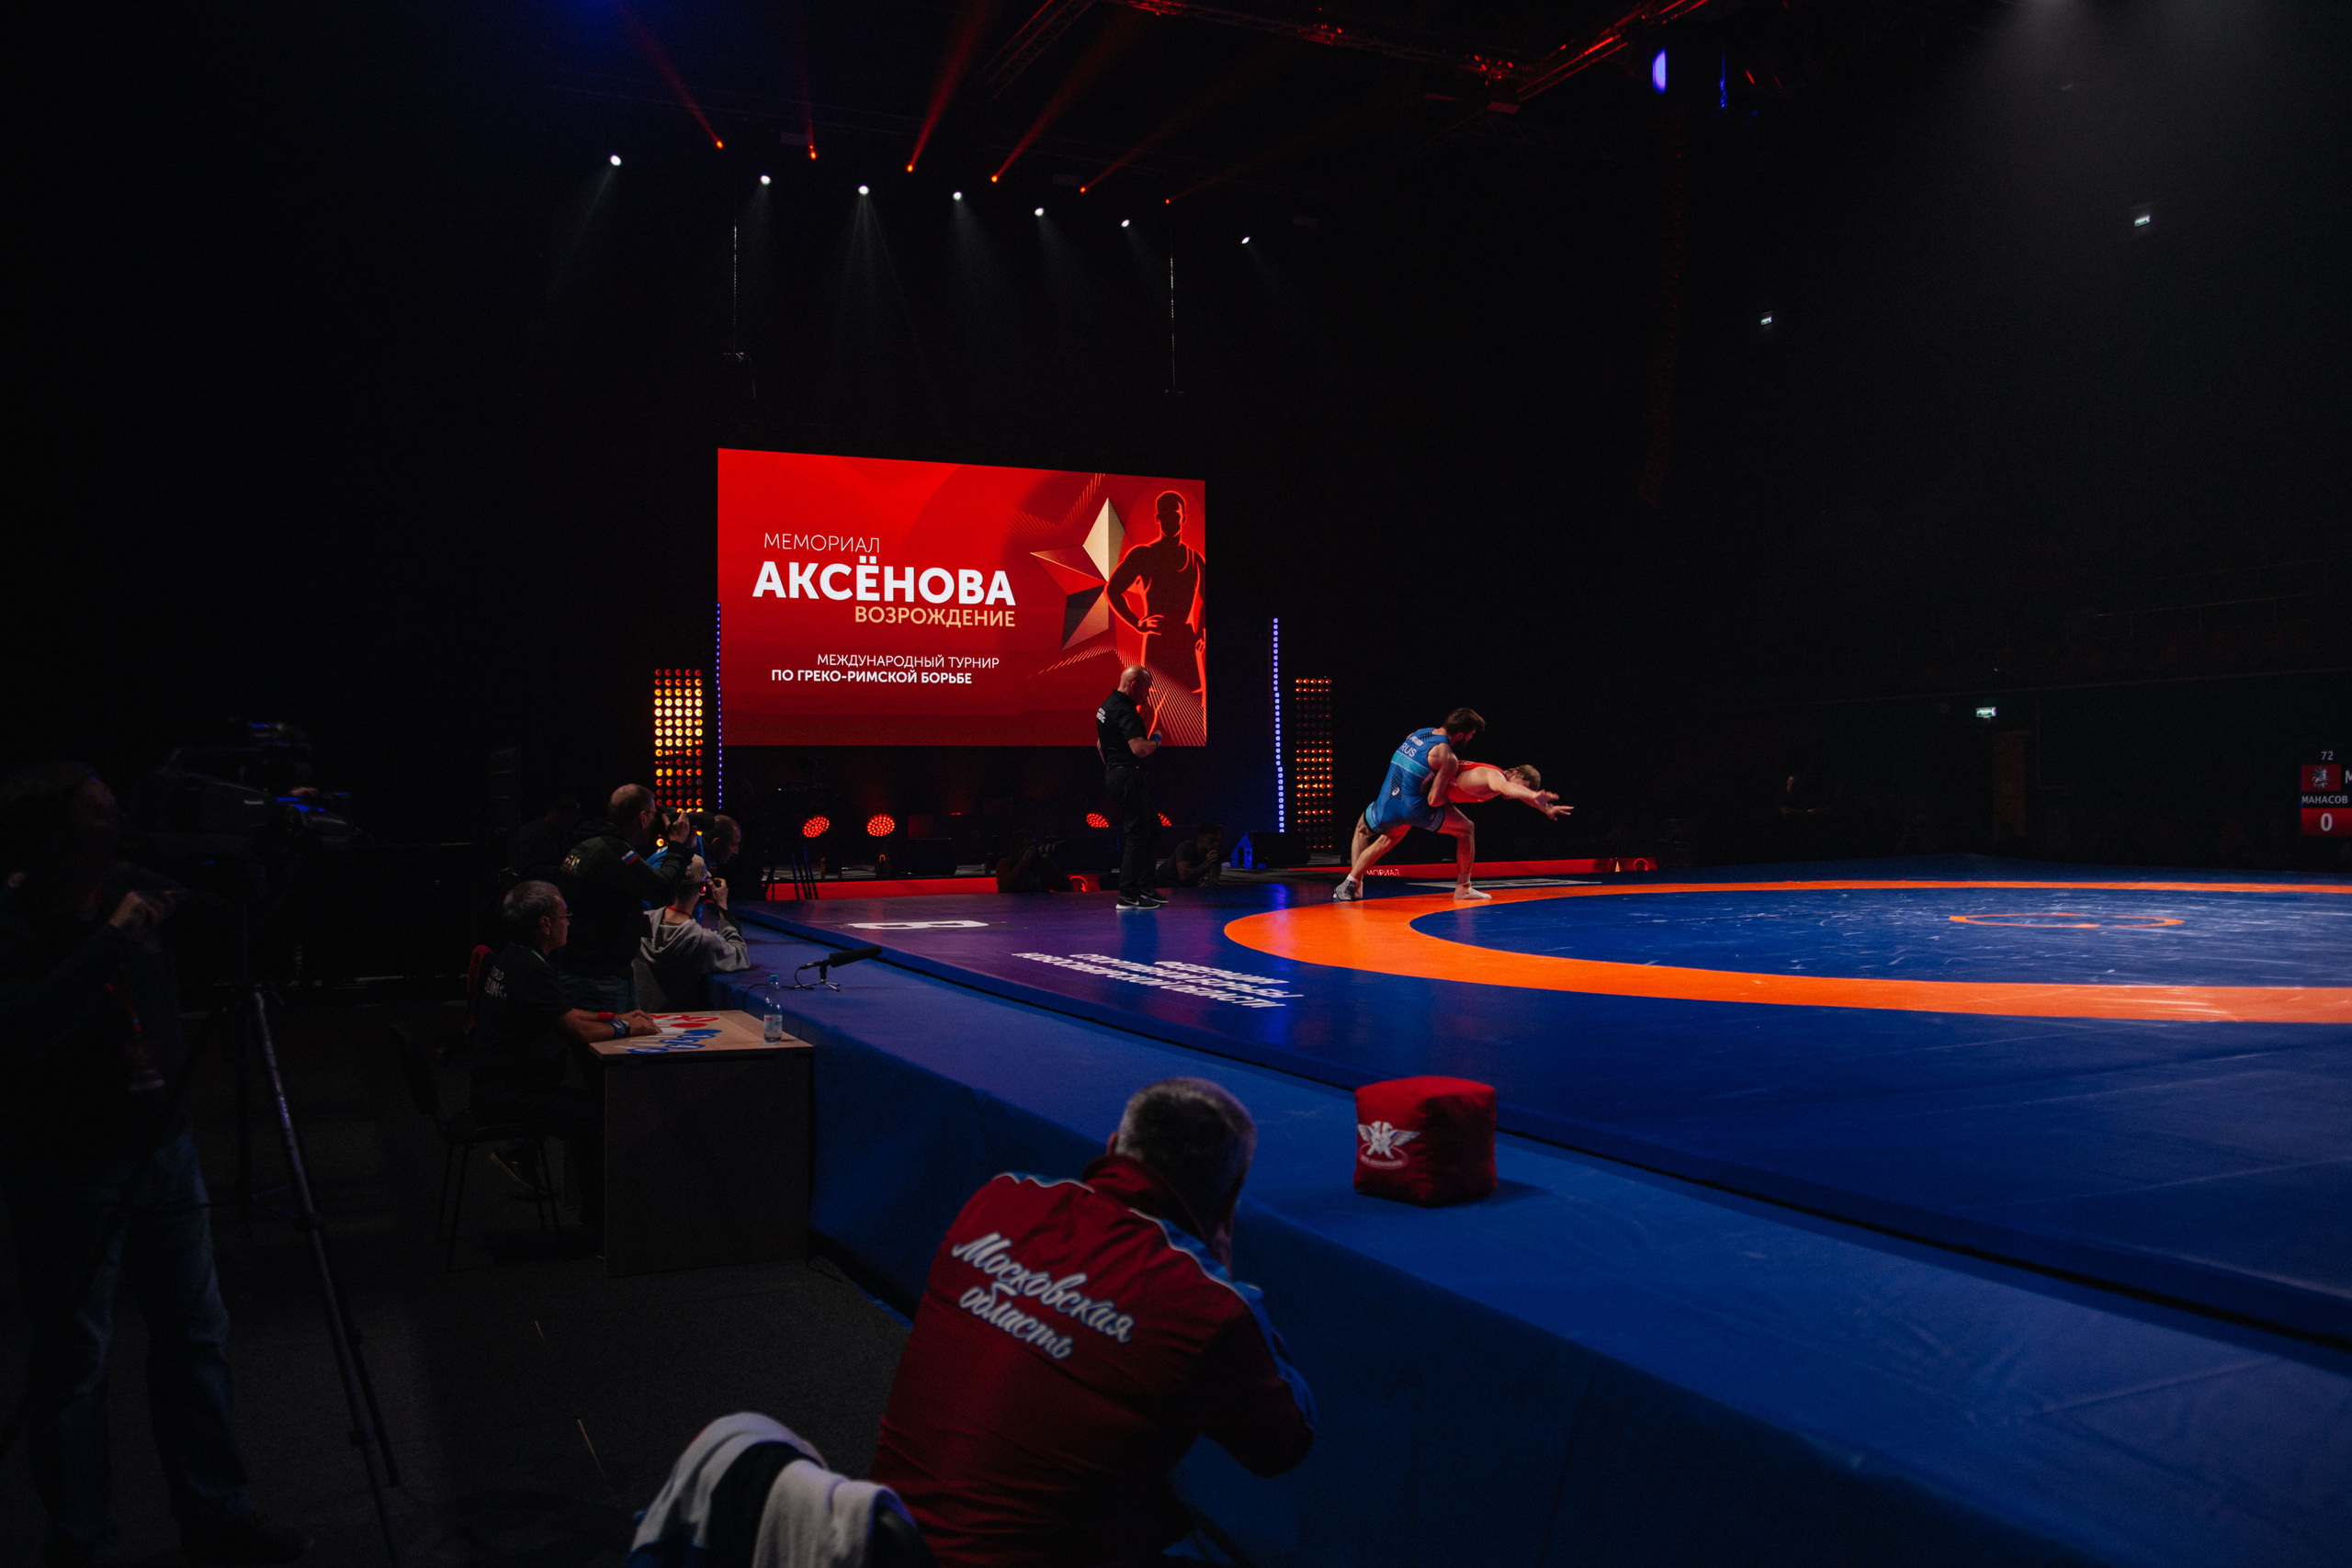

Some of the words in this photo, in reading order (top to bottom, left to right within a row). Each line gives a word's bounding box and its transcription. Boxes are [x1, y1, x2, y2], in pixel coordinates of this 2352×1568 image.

[763, 532, 880, 553] МЕМОРИАЛ
[752, 556, 1016, 606] АКСЁНОВА
[854, 605, 1016, 627] ВОЗРОЖДЕНИЕ
[817, 653, 944, 668] МЕЖДУНАРОДНЫЙ
[948, 656, 1000, 669] ТУРНИР
[772, 669, 793, 682] ПО
[797, 669, 917, 683] ГРЕКО-РИМСКОЙ
[922, 671, 972, 684] БОРЬБЕ
[1399, 742, 1418, 758] RUS
[2321, 750, 2334, 761] 72
[2301, 795, 2348, 804] МАНАСОВ
[2320, 812, 2333, 831] 0
[1366, 868, 1400, 876] МОРИАЛ
[951, 1231, 1135, 1344] Московская
[958, 1280, 1074, 1359] область
